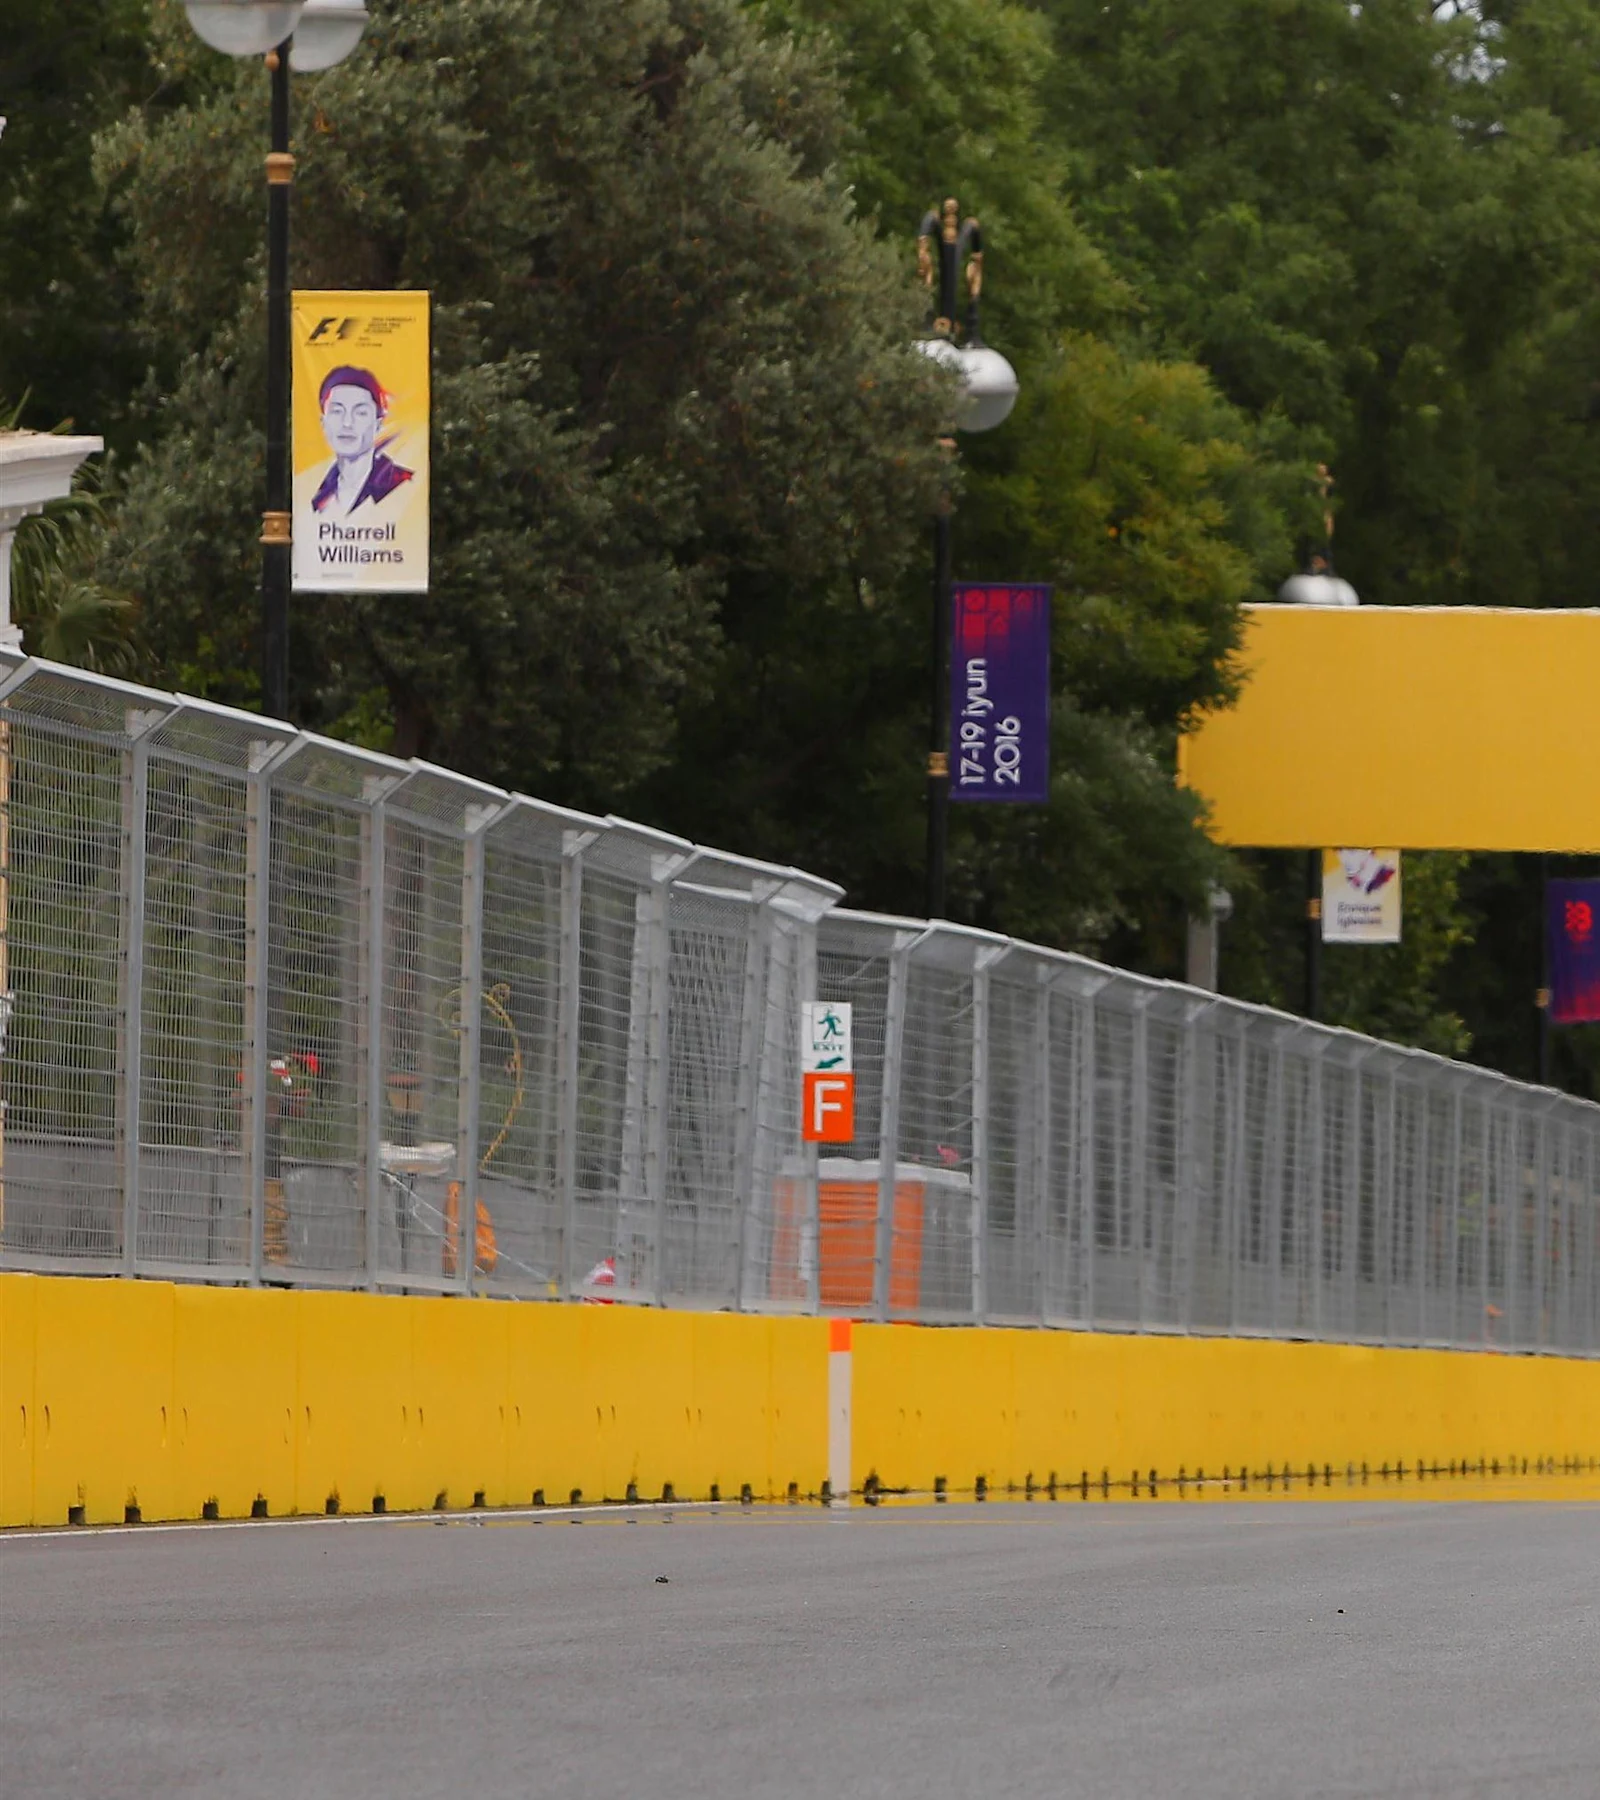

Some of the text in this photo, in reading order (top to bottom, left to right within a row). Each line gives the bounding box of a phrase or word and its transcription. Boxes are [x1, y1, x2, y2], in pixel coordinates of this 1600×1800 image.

[318, 522, 397, 541] Pharrell
[318, 545, 405, 564] Williams
[959, 657, 995, 786] 17-19 iyun
[993, 715, 1022, 786] 2016
[812, 1043, 845, 1052] EXIT
[814, 1080, 847, 1133] F
